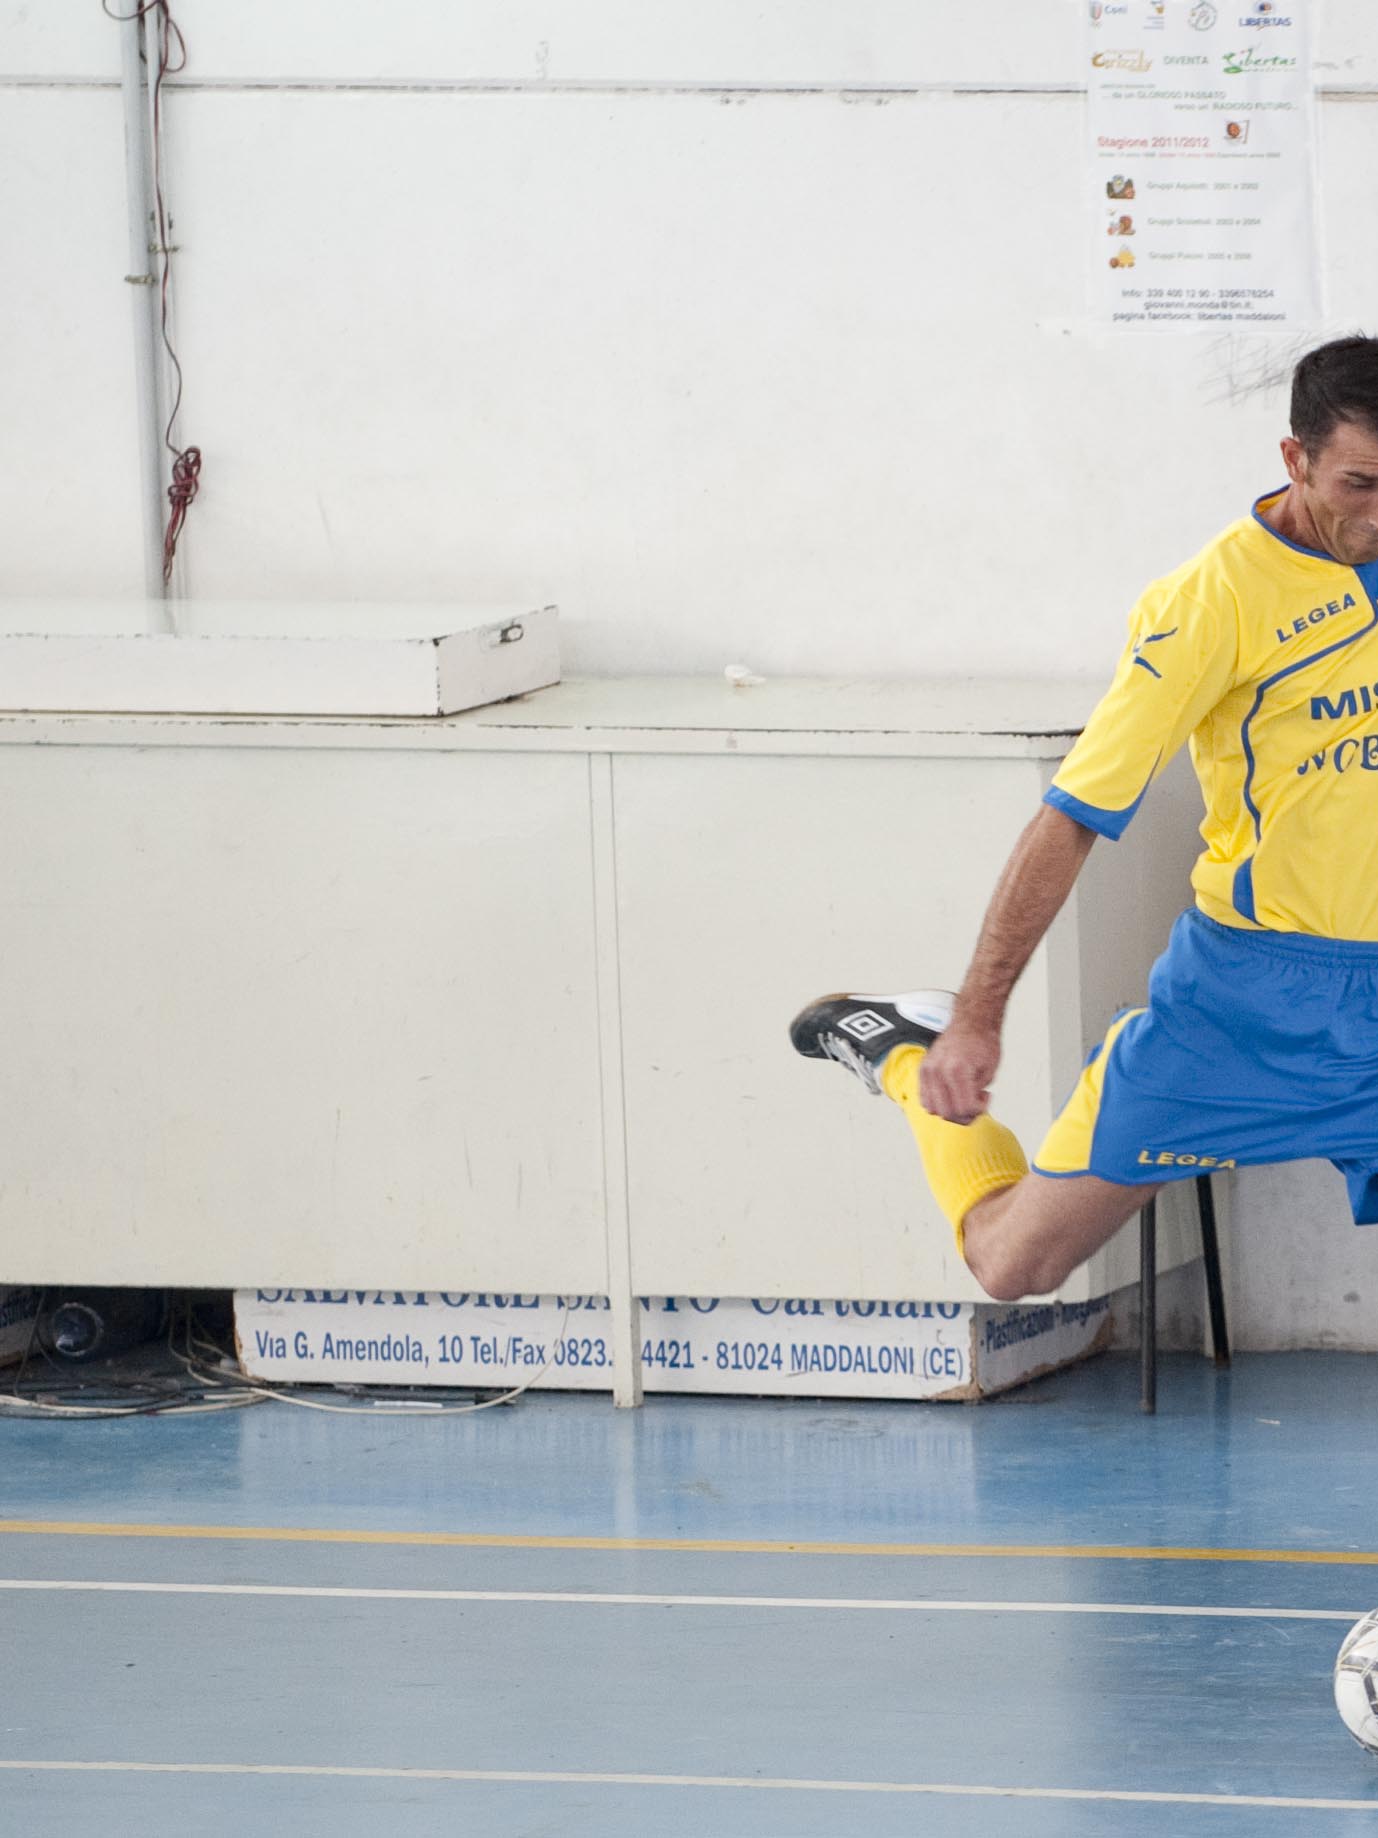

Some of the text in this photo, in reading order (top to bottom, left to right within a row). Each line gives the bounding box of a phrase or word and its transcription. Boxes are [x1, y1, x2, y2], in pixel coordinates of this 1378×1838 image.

[1238, 17, 1292, 28] LIBERTAS
[1163, 55, 1210, 66] DIVENTA
[1097, 136, 1210, 150] Stagione 2011/2012
[1113, 312, 1145, 323] pagina
[1275, 592, 1357, 642] LEGEA
[1137, 1149, 1237, 1170] LEGEA
[255, 1330, 287, 1359] Via
[294, 1331, 315, 1360] G.
[322, 1332, 430, 1368] Amendola,
[438, 1335, 464, 1363] 10
[470, 1335, 546, 1368] Tel./Fax
[716, 1341, 784, 1372] 81024
[790, 1343, 916, 1375] MADDALONI
[921, 1345, 964, 1380] (CE)
